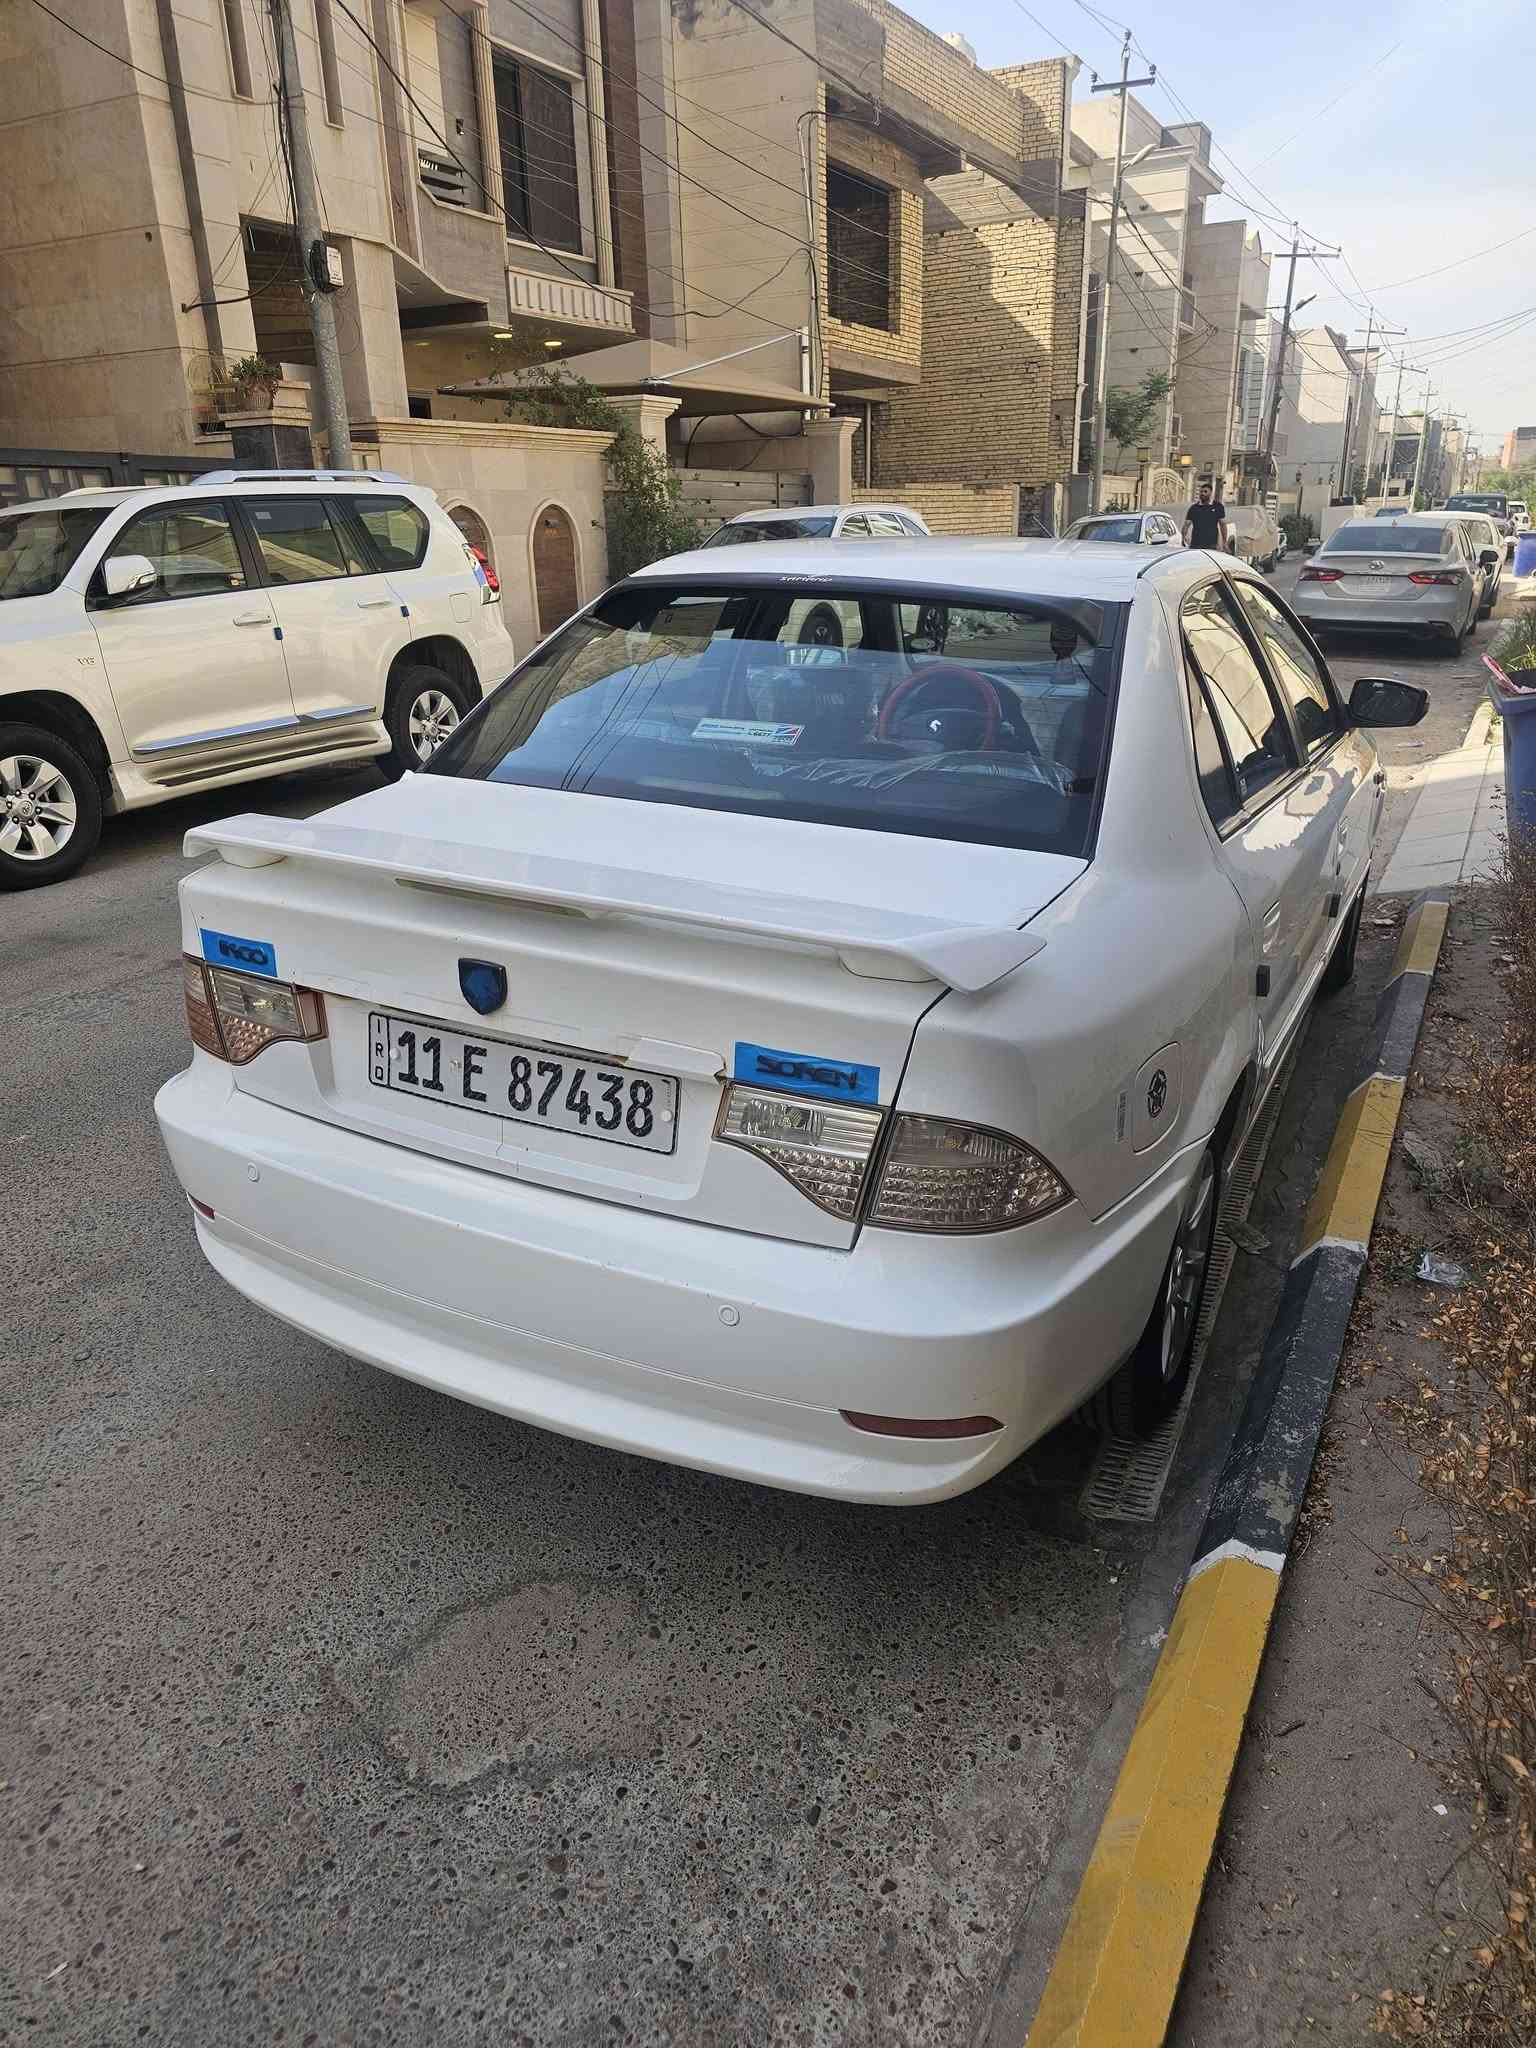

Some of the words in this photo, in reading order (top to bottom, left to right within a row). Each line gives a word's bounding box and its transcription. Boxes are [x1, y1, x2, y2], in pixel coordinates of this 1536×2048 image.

[398, 1030, 444, 1092] 11
[463, 1044, 488, 1102] E
[508, 1055, 654, 1138] 87438
